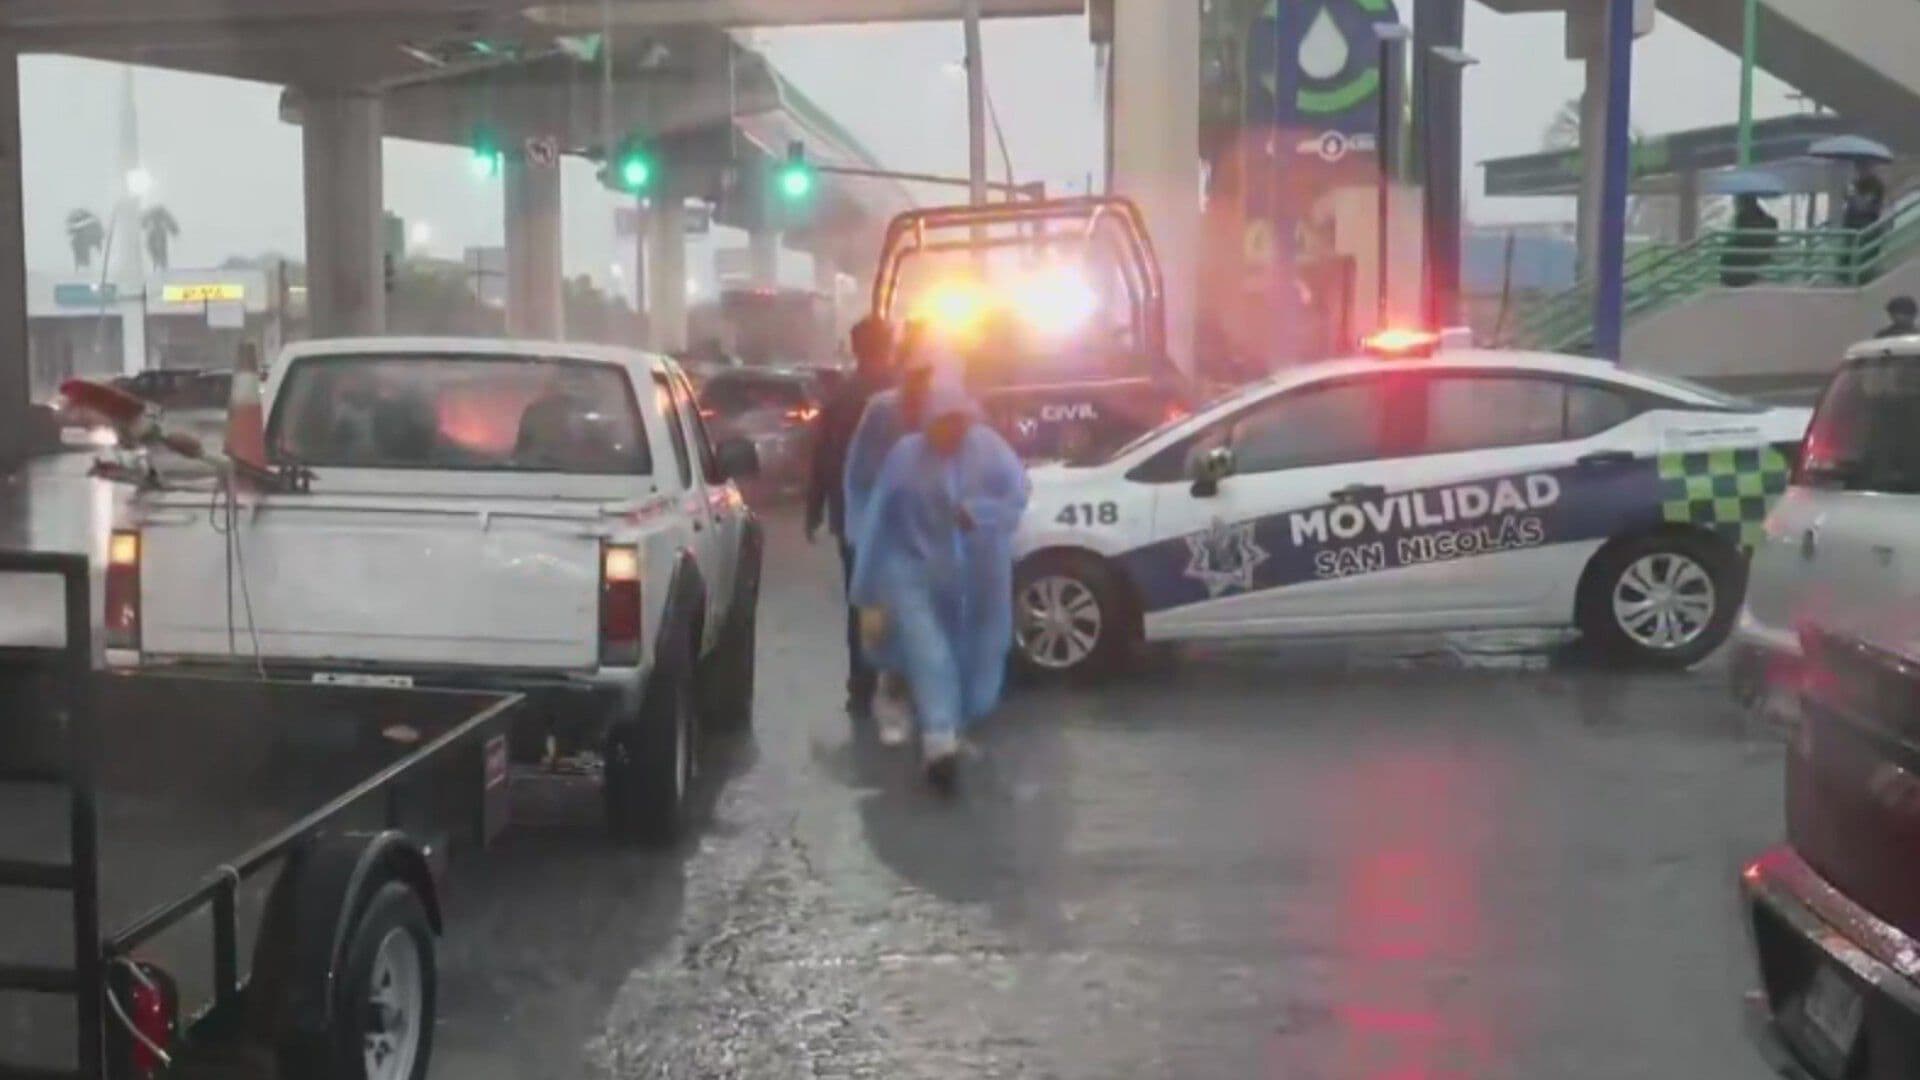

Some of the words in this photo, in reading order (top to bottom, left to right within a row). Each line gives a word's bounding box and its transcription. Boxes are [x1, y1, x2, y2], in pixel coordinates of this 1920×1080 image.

[1055, 501, 1118, 526] 418
[1290, 474, 1560, 546] MOVILIDAD
[1315, 541, 1386, 578] SAN
[1397, 513, 1546, 566] NICOLÁS
